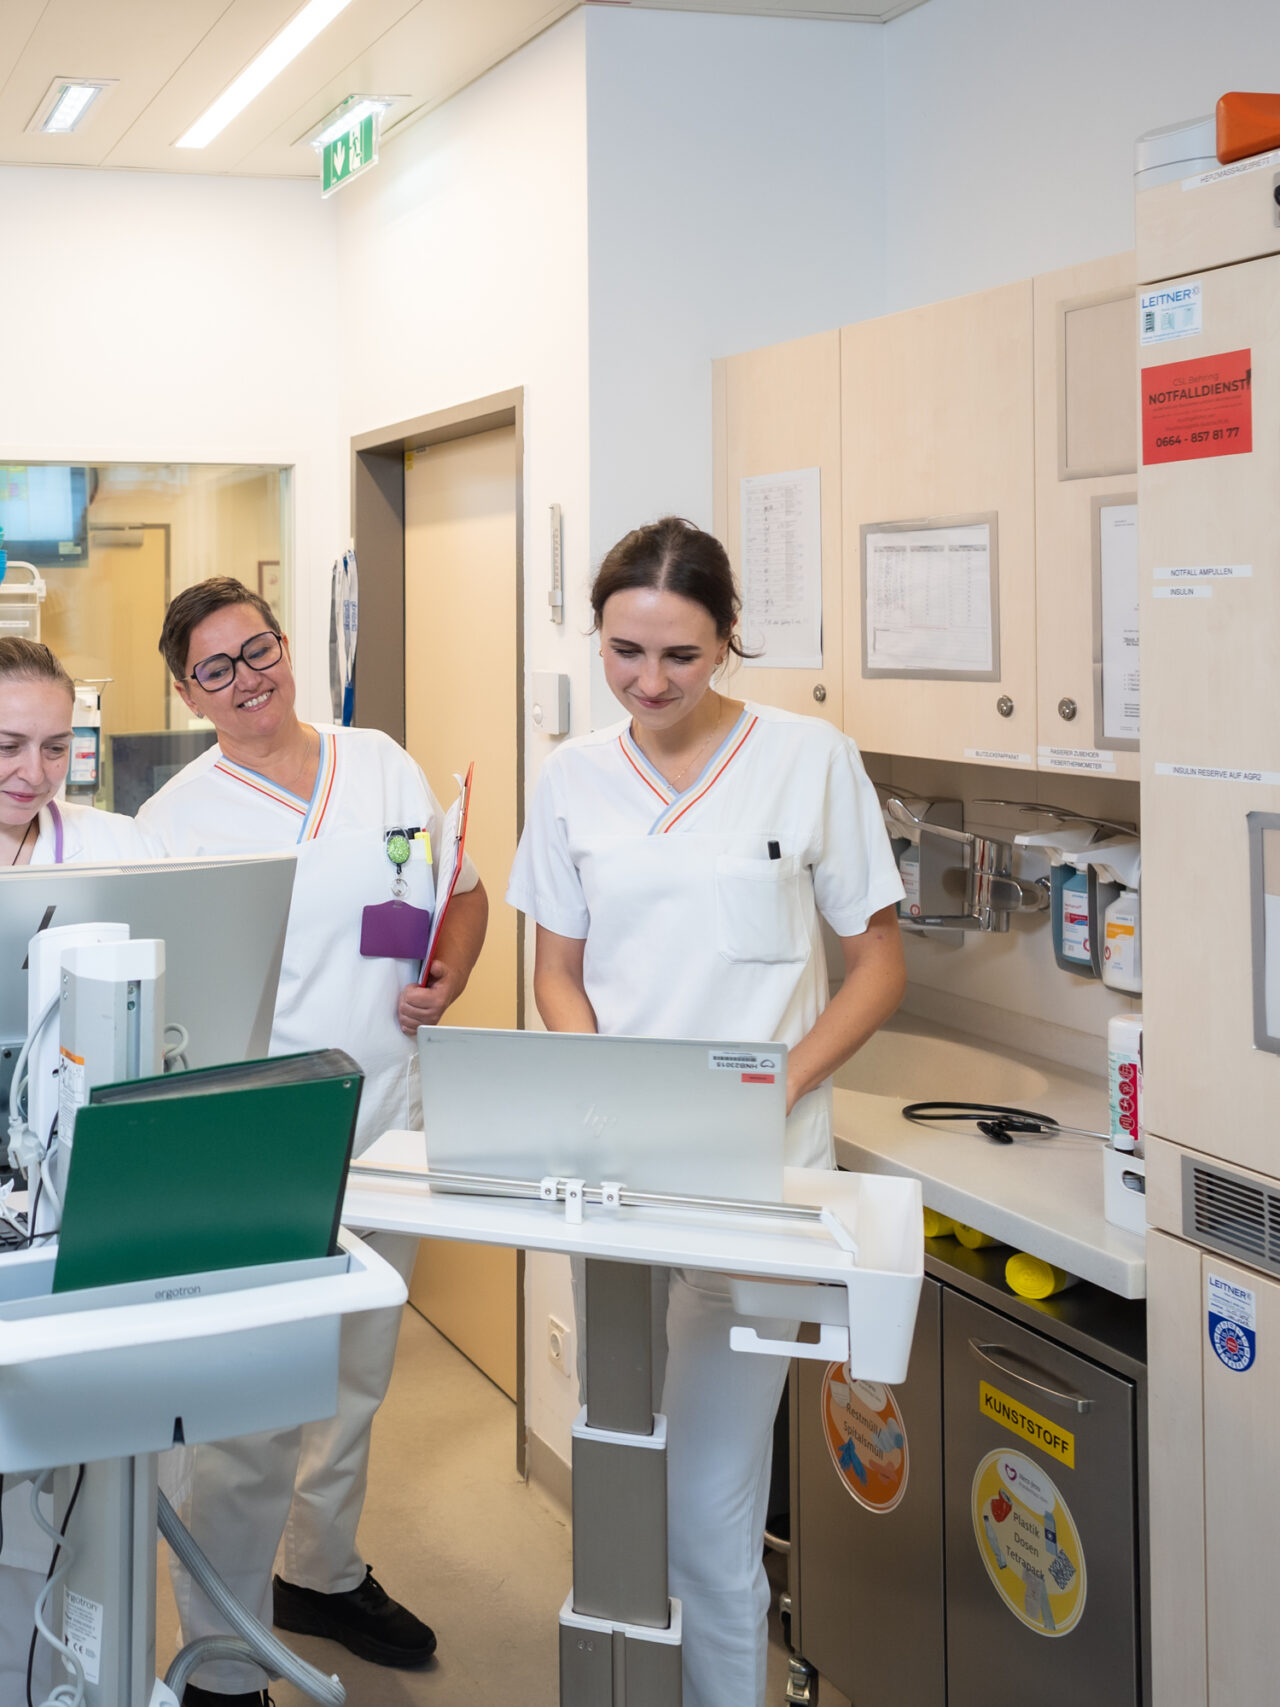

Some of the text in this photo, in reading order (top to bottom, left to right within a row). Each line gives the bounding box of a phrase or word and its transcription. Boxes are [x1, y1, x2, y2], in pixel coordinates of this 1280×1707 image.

[1142, 288, 1191, 309] LEITNER
[1148, 379, 1246, 405] NOTFALLDIENST
[1155, 435, 1182, 448] 0664
[1190, 430, 1210, 443] 857
[1212, 428, 1224, 441] 81
[1226, 427, 1240, 438] 77
[1170, 568, 1233, 577] NOTFALL AMPULLEN
[1170, 588, 1194, 596] INSULIN
[1172, 766, 1197, 775] INSULIN
[1197, 768, 1228, 778] RESERVE
[1228, 771, 1242, 779] AUF
[154, 1286, 201, 1300] ergotron
[1209, 1275, 1247, 1301] LEITNER
[985, 1393, 1070, 1454] KUNSTSTOFF
[1012, 1511, 1041, 1539] Plastik
[1013, 1532, 1040, 1558] Dosen
[1005, 1545, 1045, 1580] Tetrapack
